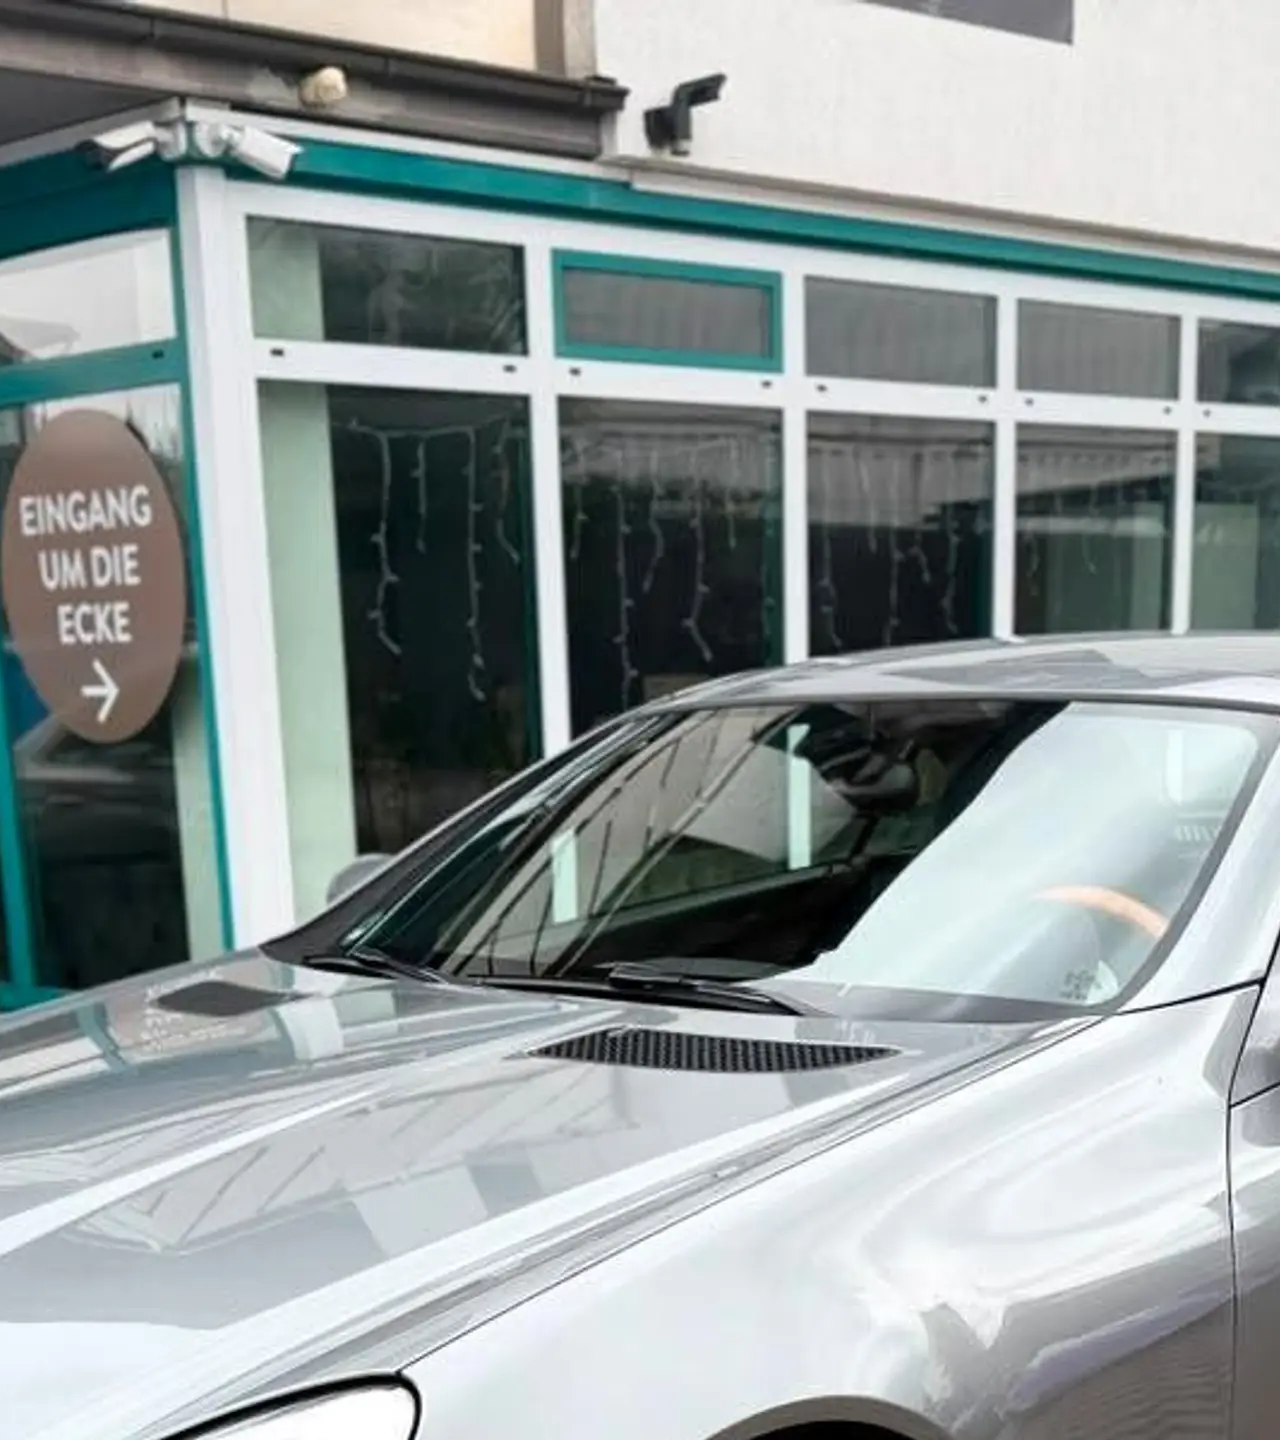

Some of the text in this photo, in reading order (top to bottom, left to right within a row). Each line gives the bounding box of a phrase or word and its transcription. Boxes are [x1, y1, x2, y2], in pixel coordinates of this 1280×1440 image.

[20, 485, 152, 536] EINGANG
[38, 544, 141, 590] UM DIE
[57, 603, 133, 644] ECKE
